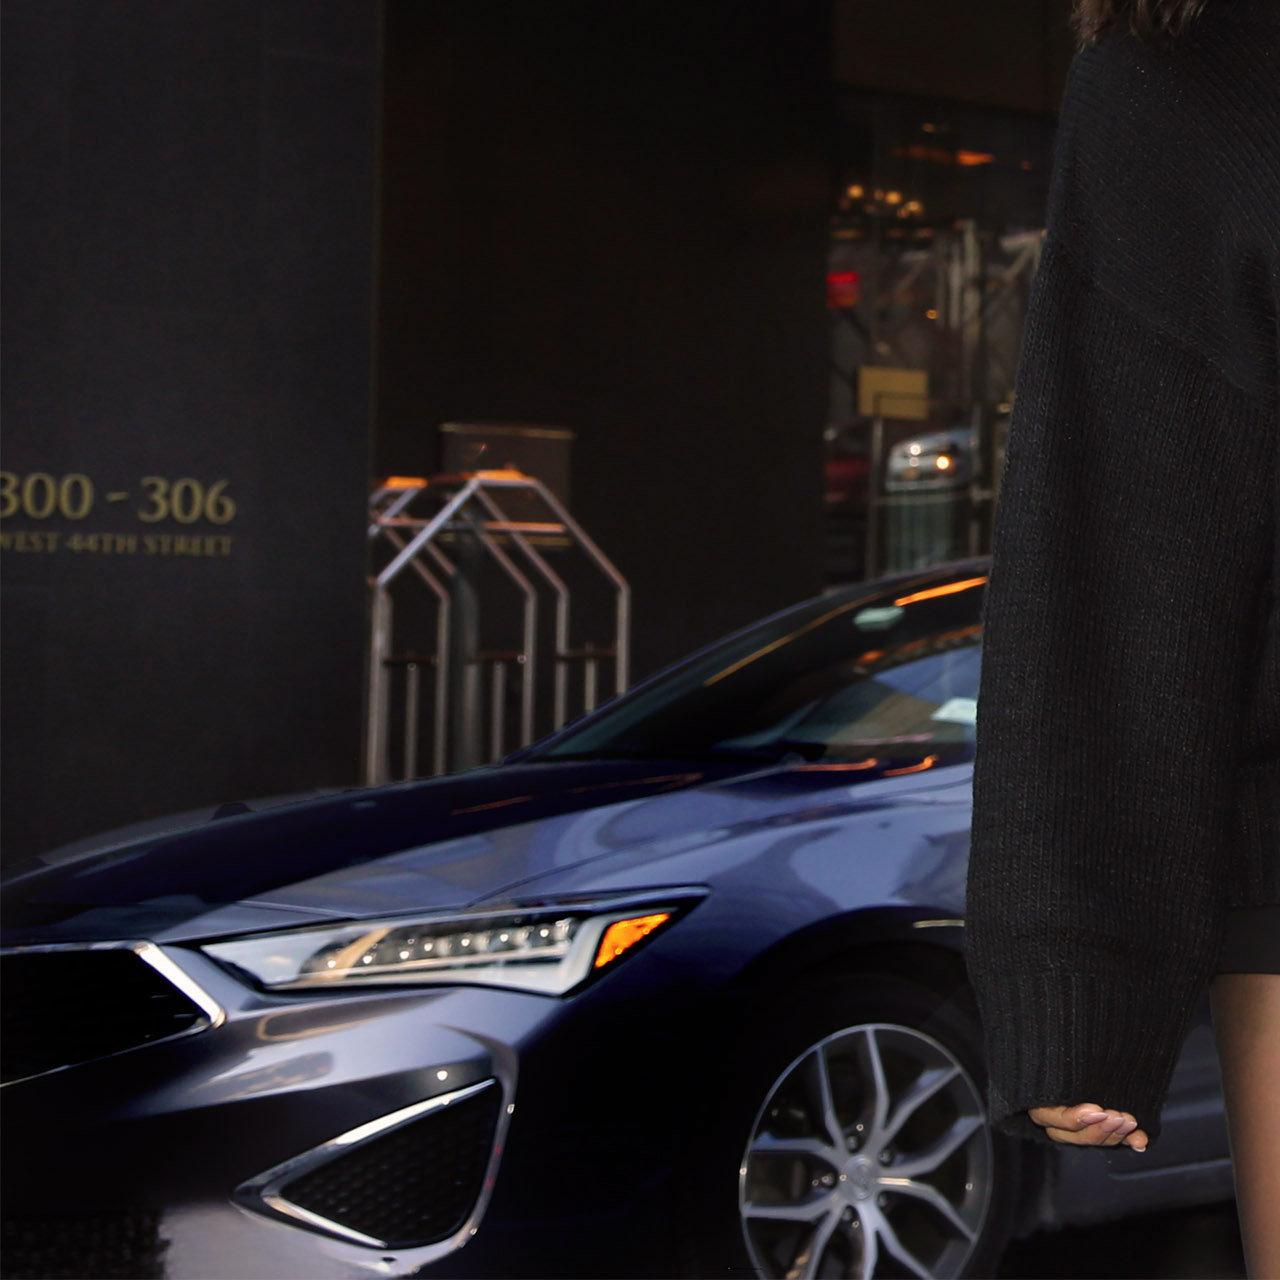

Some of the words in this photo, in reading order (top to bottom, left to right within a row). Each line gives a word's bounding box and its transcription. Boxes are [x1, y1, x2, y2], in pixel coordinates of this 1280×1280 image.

[0, 472, 95, 519] 300
[138, 476, 237, 525] 306
[66, 532, 138, 555] 44TH
[143, 534, 233, 557] STREET
